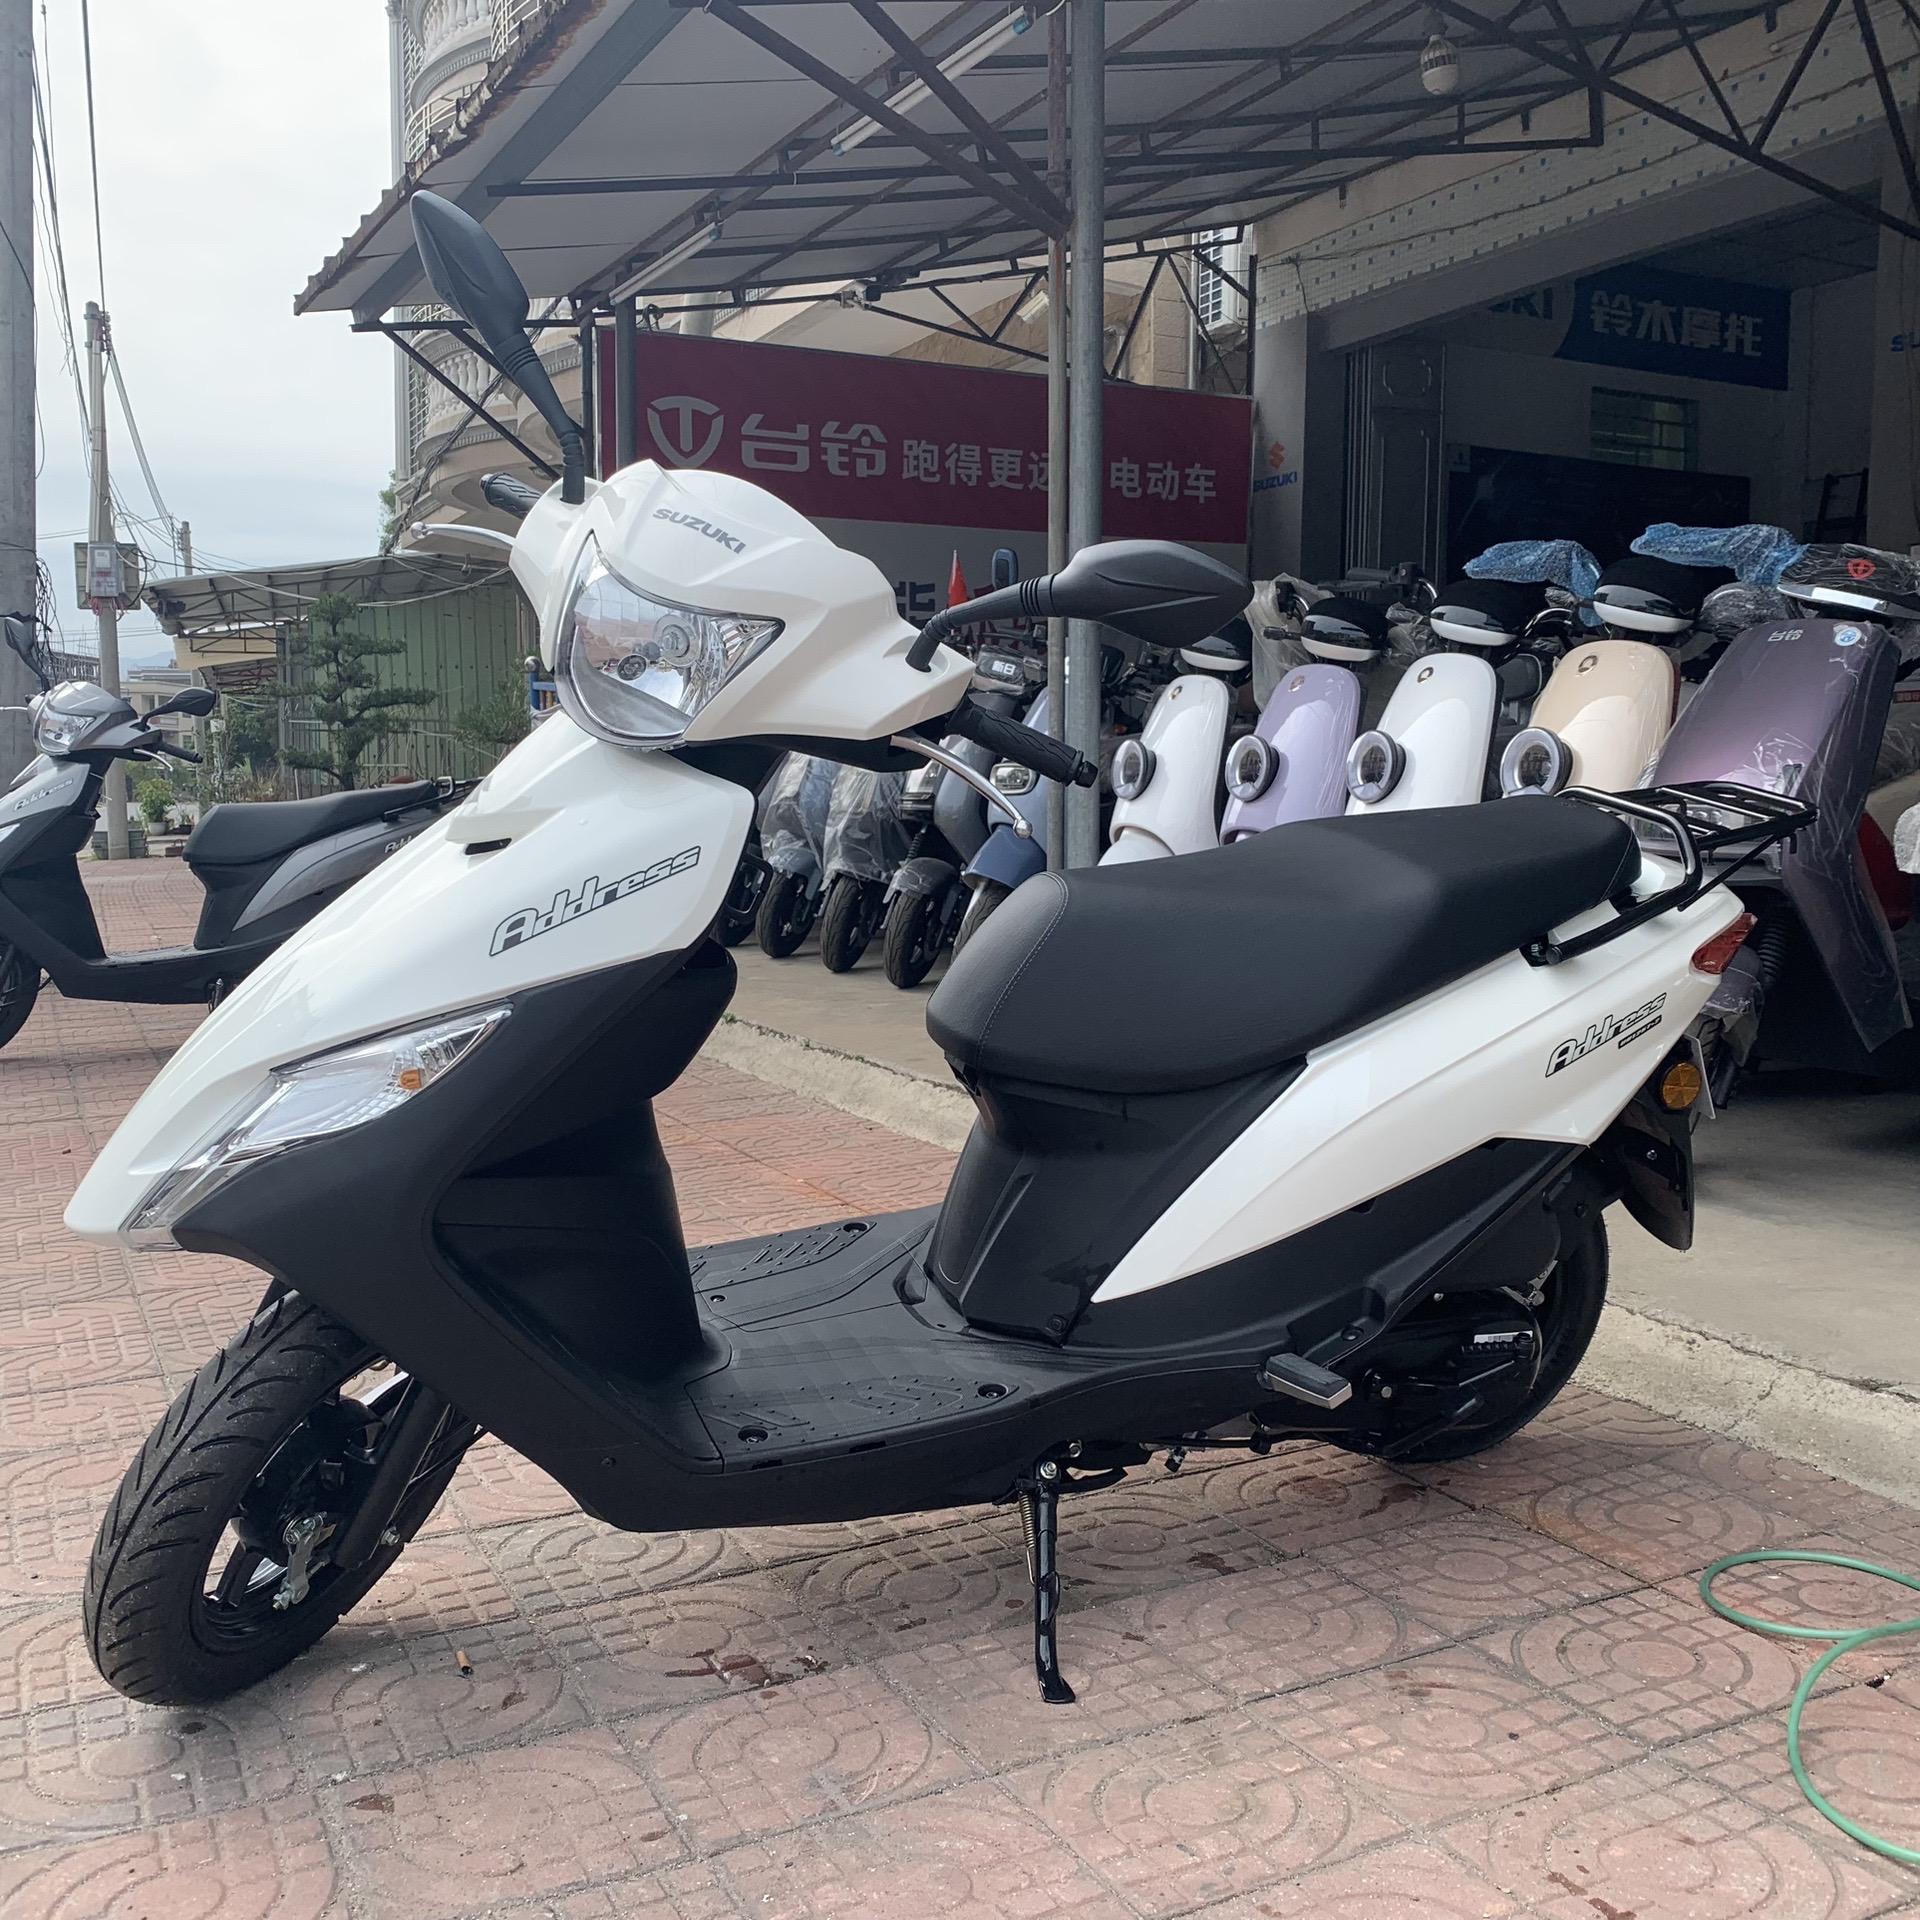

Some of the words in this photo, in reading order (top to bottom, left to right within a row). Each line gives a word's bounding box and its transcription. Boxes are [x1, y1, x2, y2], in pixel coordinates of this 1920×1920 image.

[1590, 289, 1763, 357] 铃木摩托
[741, 413, 888, 478] 台铃
[1253, 471, 1298, 493] SUZUKI
[652, 508, 746, 554] SUZUKI
[489, 845, 701, 957] Address
[1545, 992, 1667, 1078] Address
